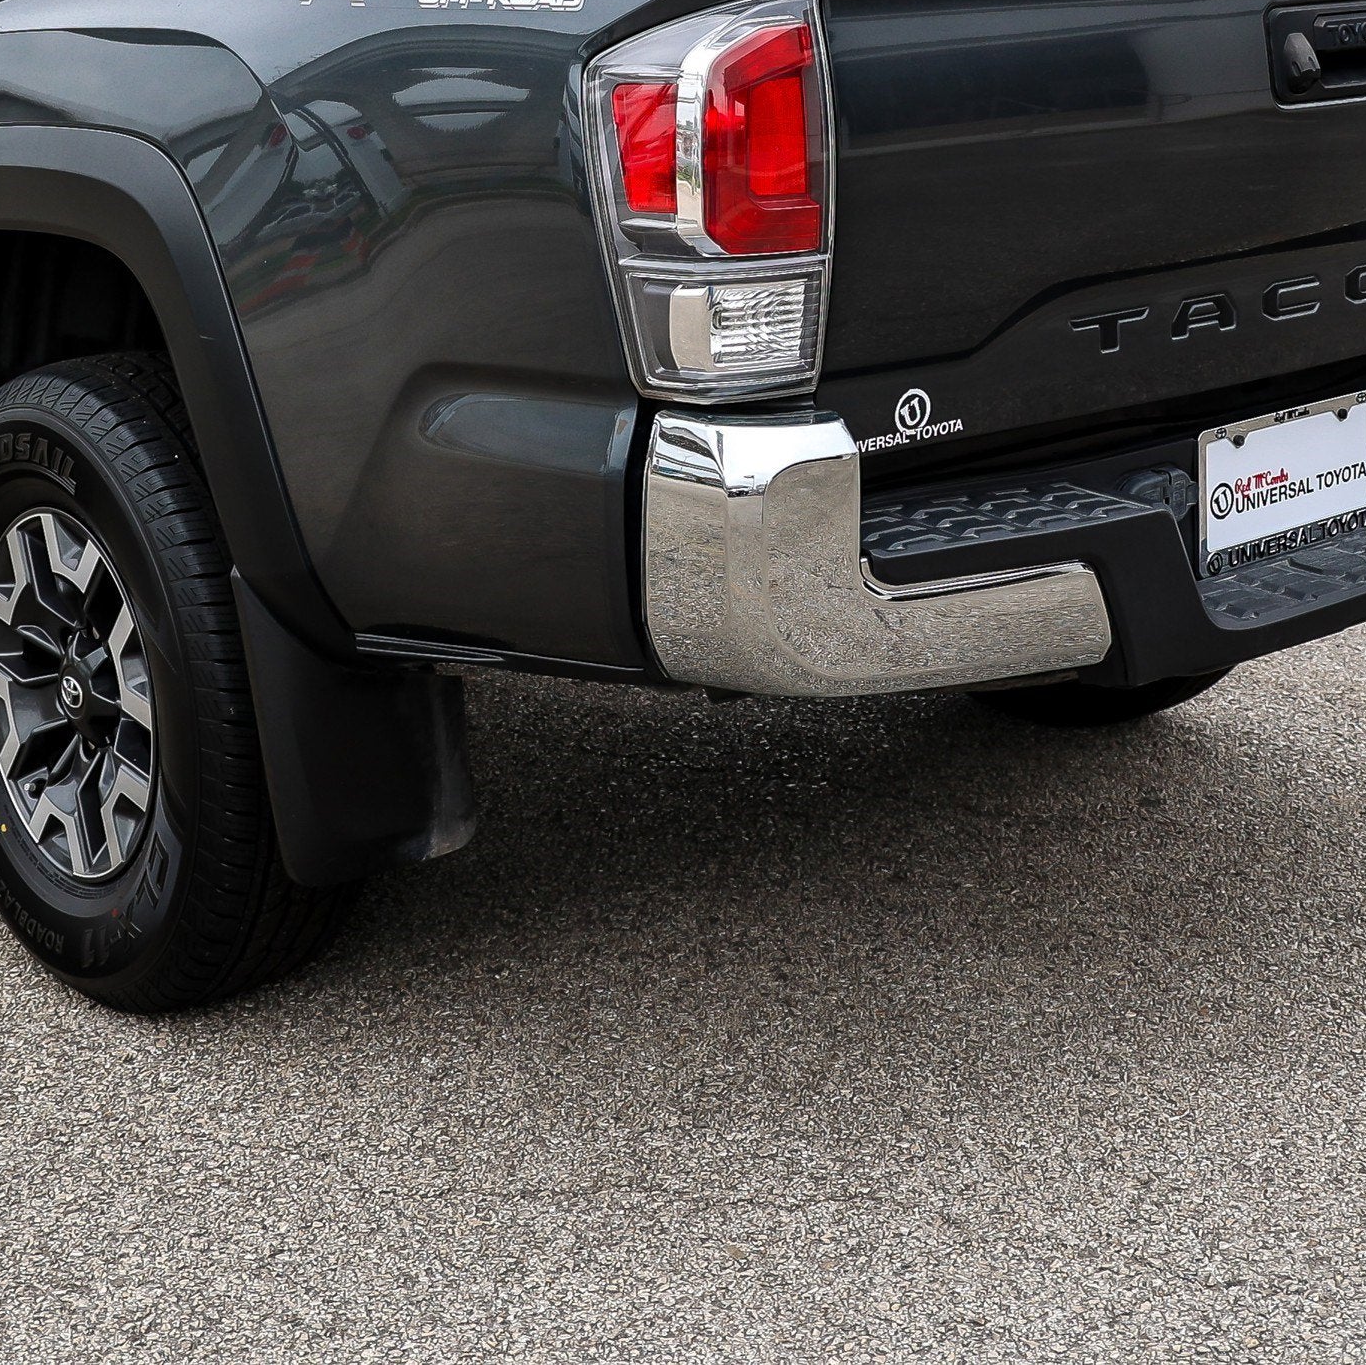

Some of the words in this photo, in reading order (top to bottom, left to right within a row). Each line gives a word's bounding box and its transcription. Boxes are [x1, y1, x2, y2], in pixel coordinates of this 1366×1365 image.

[914, 418, 965, 441] TOYOTA
[1234, 475, 1252, 498] Red
[1234, 480, 1315, 515] UNIVERSAL
[1227, 525, 1318, 569] UNIVERSAL
